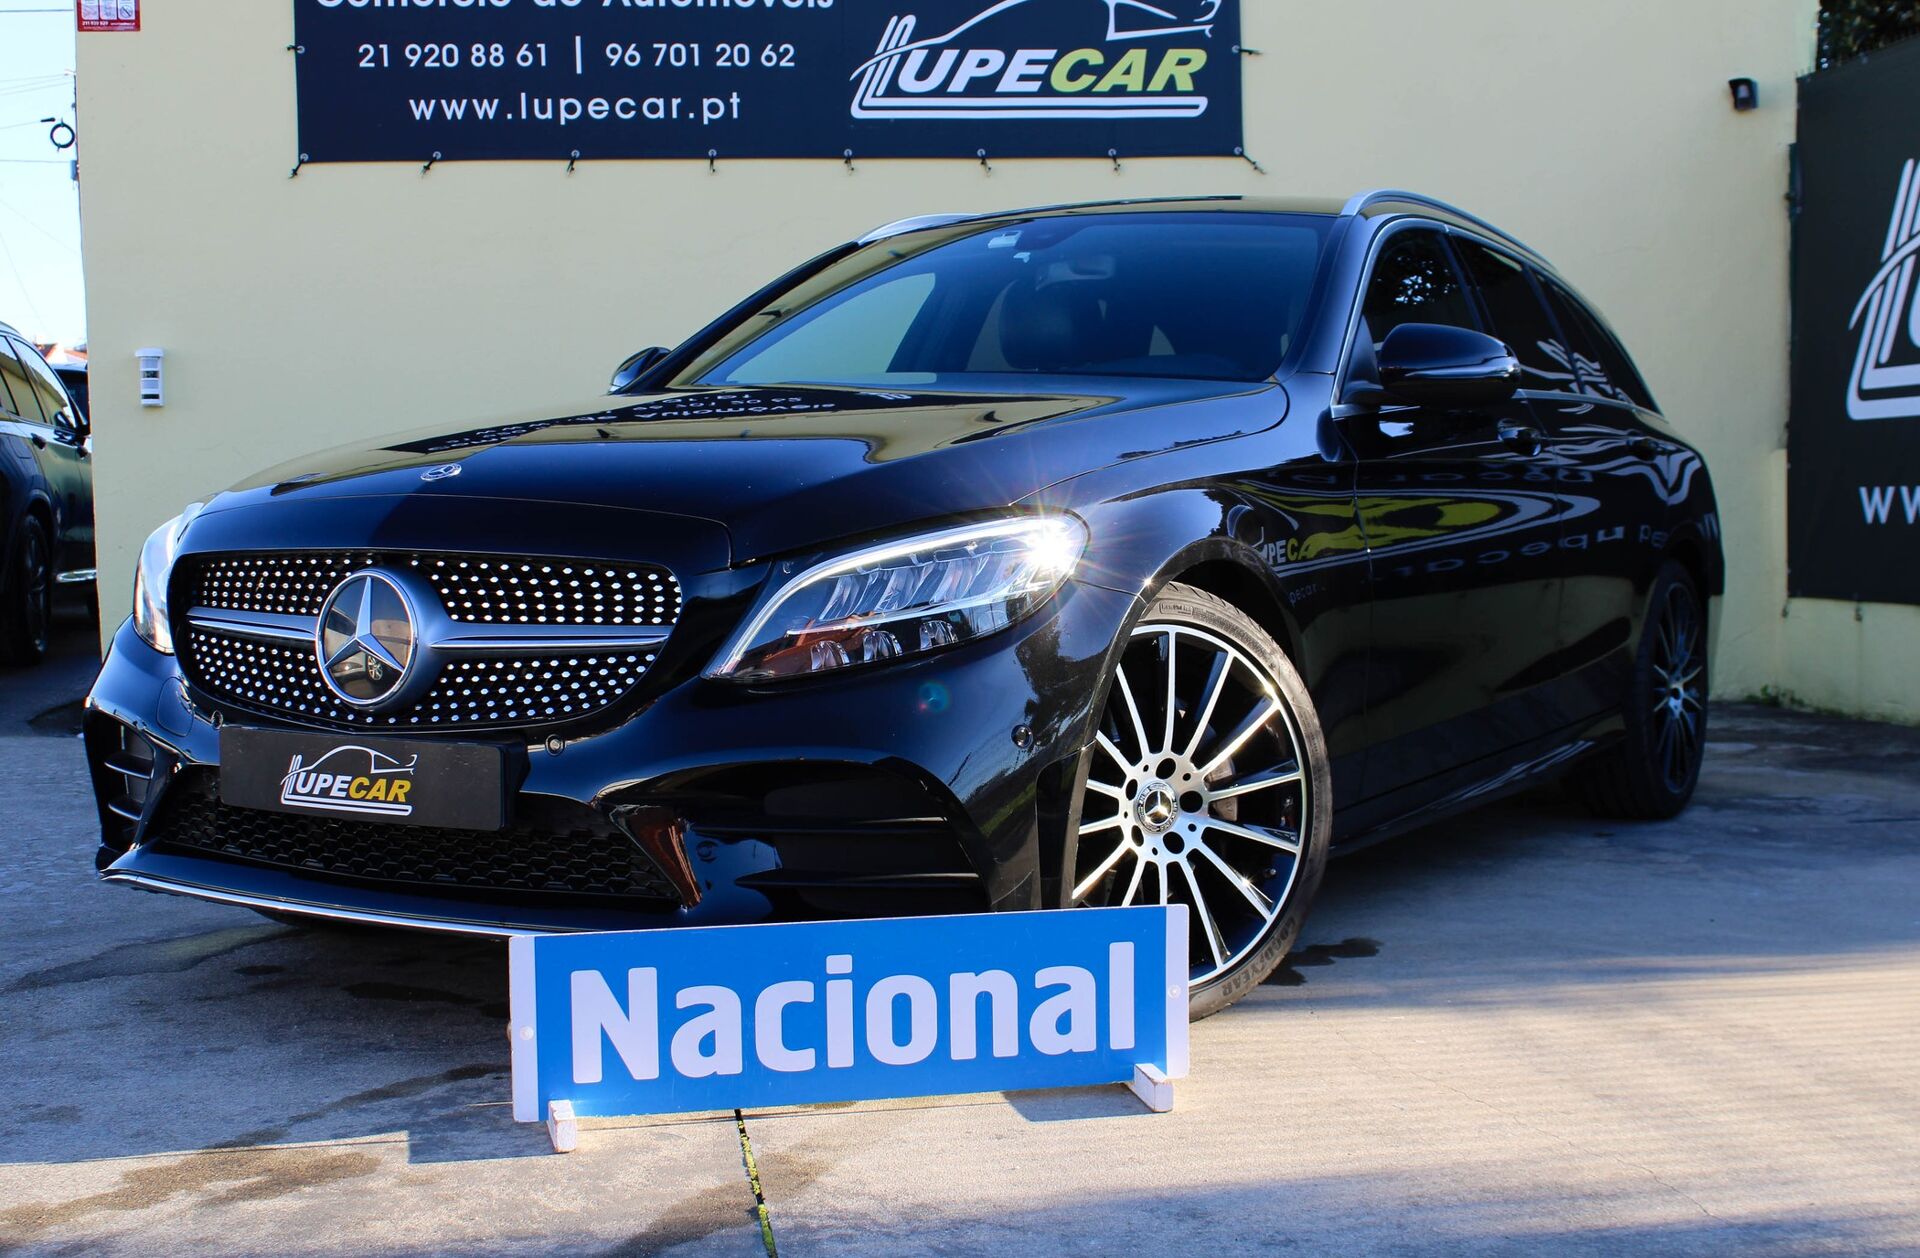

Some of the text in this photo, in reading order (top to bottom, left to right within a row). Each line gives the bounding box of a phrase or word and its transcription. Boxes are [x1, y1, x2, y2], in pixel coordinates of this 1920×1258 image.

[358, 43, 795, 68] 21 920 88 61 96 701 20 62
[850, 15, 1209, 119] LUPECAR
[408, 91, 741, 126] www.lupecar.pt
[281, 754, 412, 816] LUPECAR
[571, 940, 1136, 1085] Nacional
